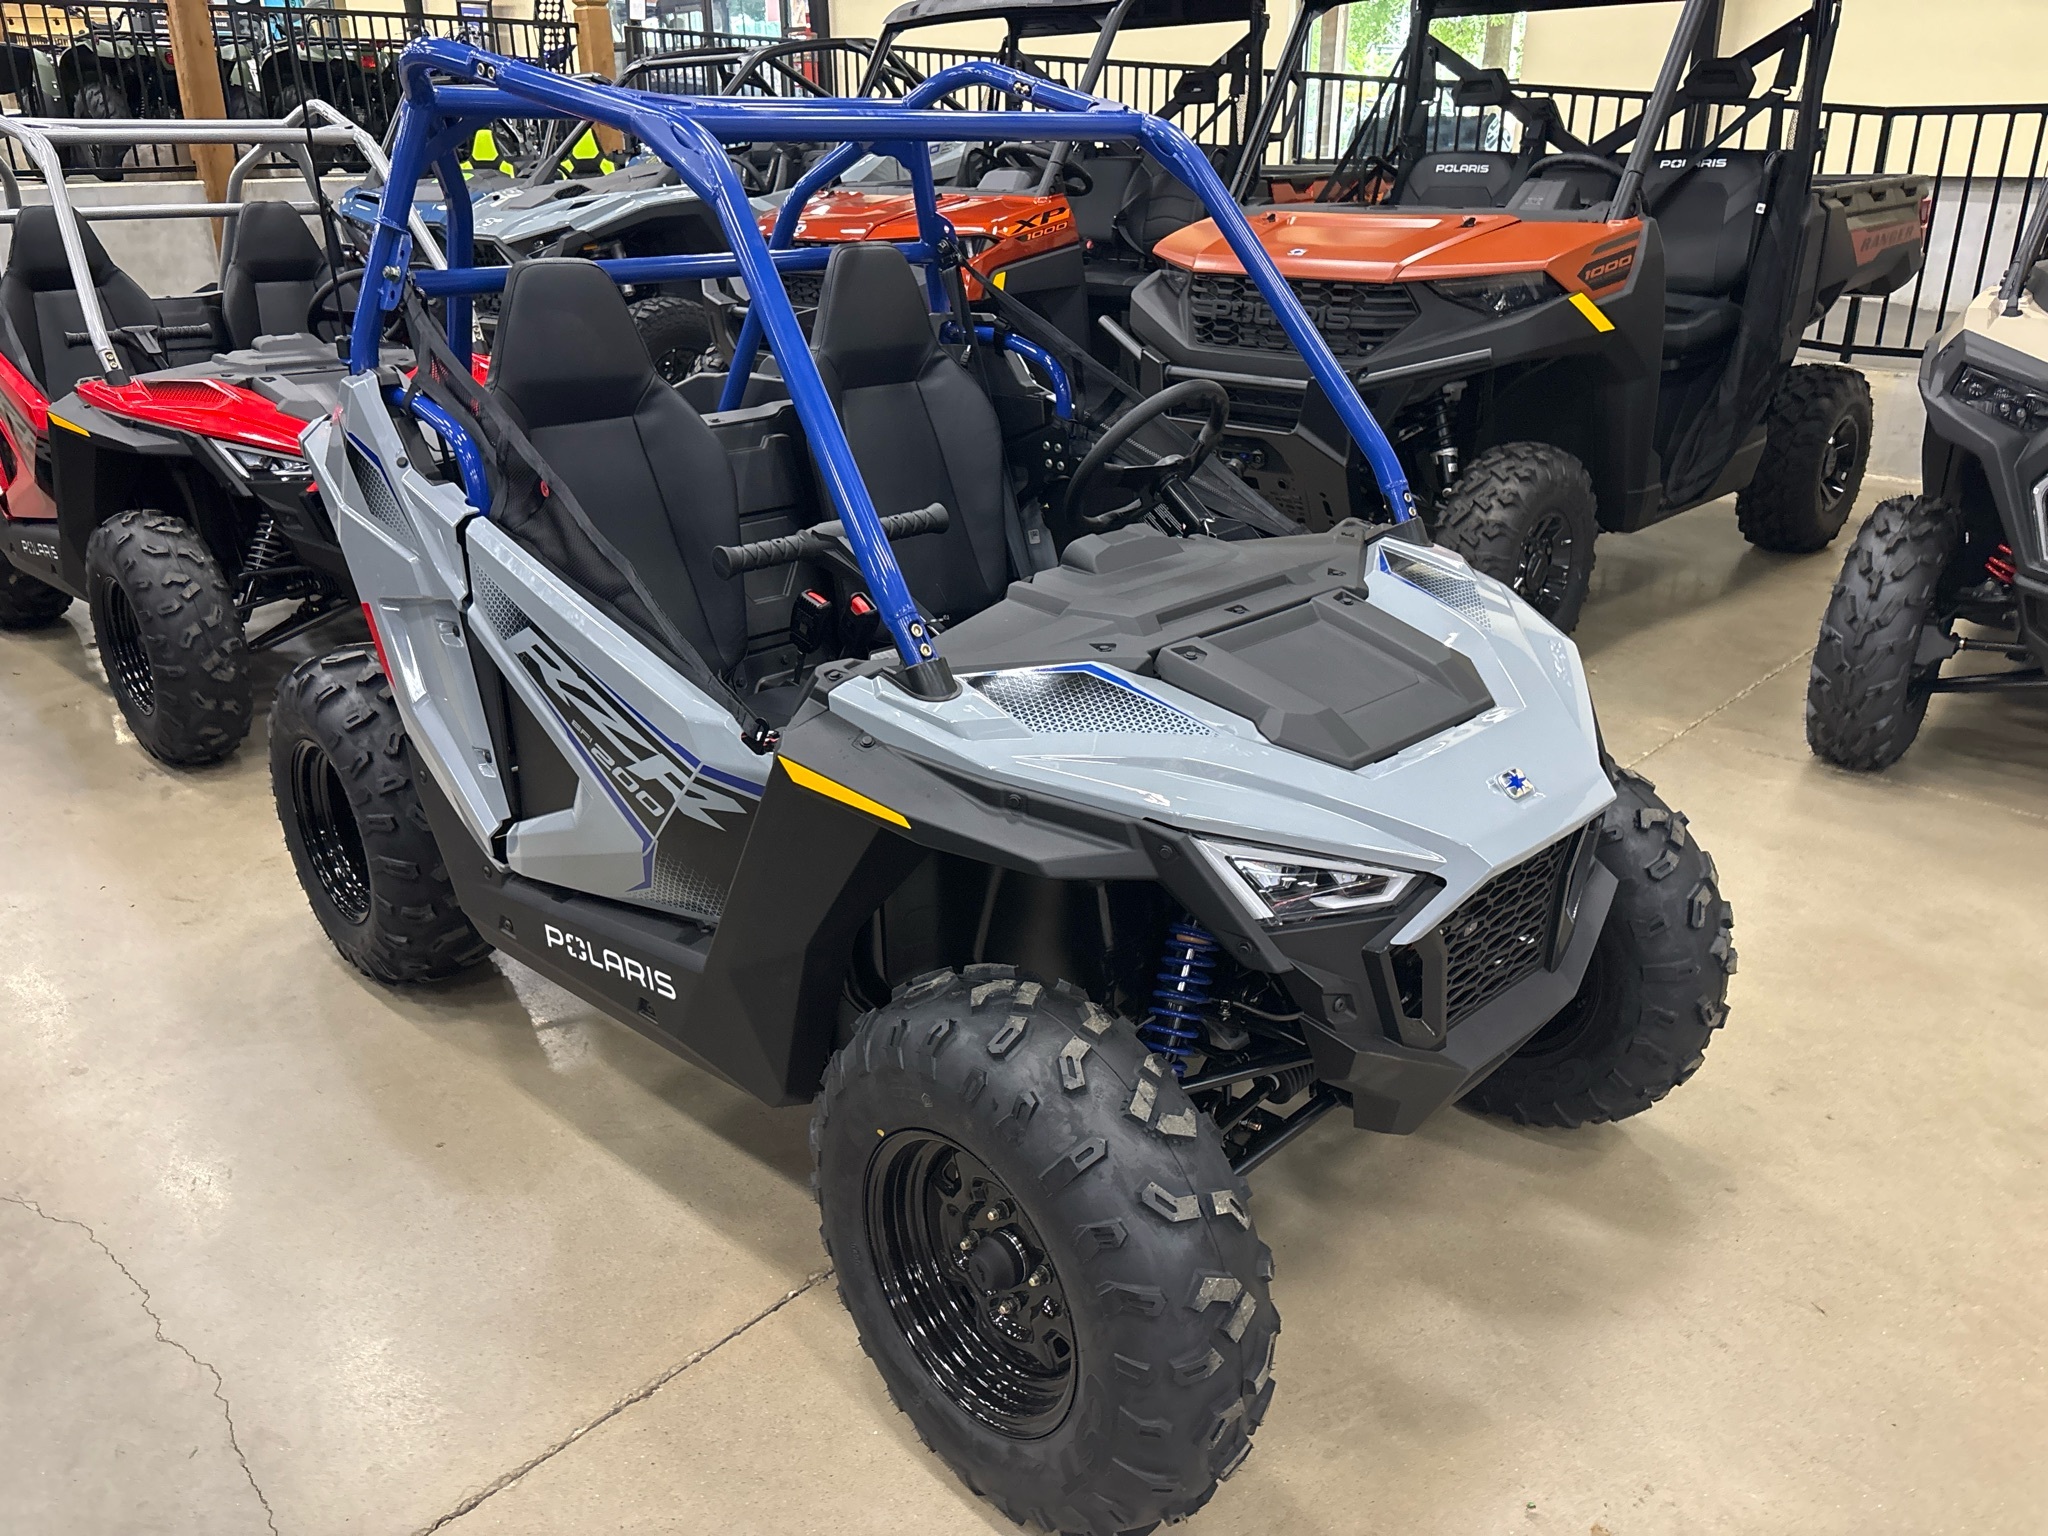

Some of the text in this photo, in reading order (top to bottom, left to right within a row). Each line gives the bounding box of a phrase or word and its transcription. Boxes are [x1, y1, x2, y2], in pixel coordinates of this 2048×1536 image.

[1435, 164, 1490, 173] POLARIS
[1659, 158, 1728, 169] POLRIS
[1012, 207, 1067, 235] XP
[1026, 221, 1068, 240] 1000
[1860, 225, 1914, 252] RANGER
[1584, 254, 1633, 280] 1000
[1210, 300, 1350, 330] POLIS
[20, 539, 59, 560] POLARIS
[505, 626, 748, 832] RZR
[571, 718, 665, 817] EFI 200
[544, 923, 677, 1000] POLARIS
